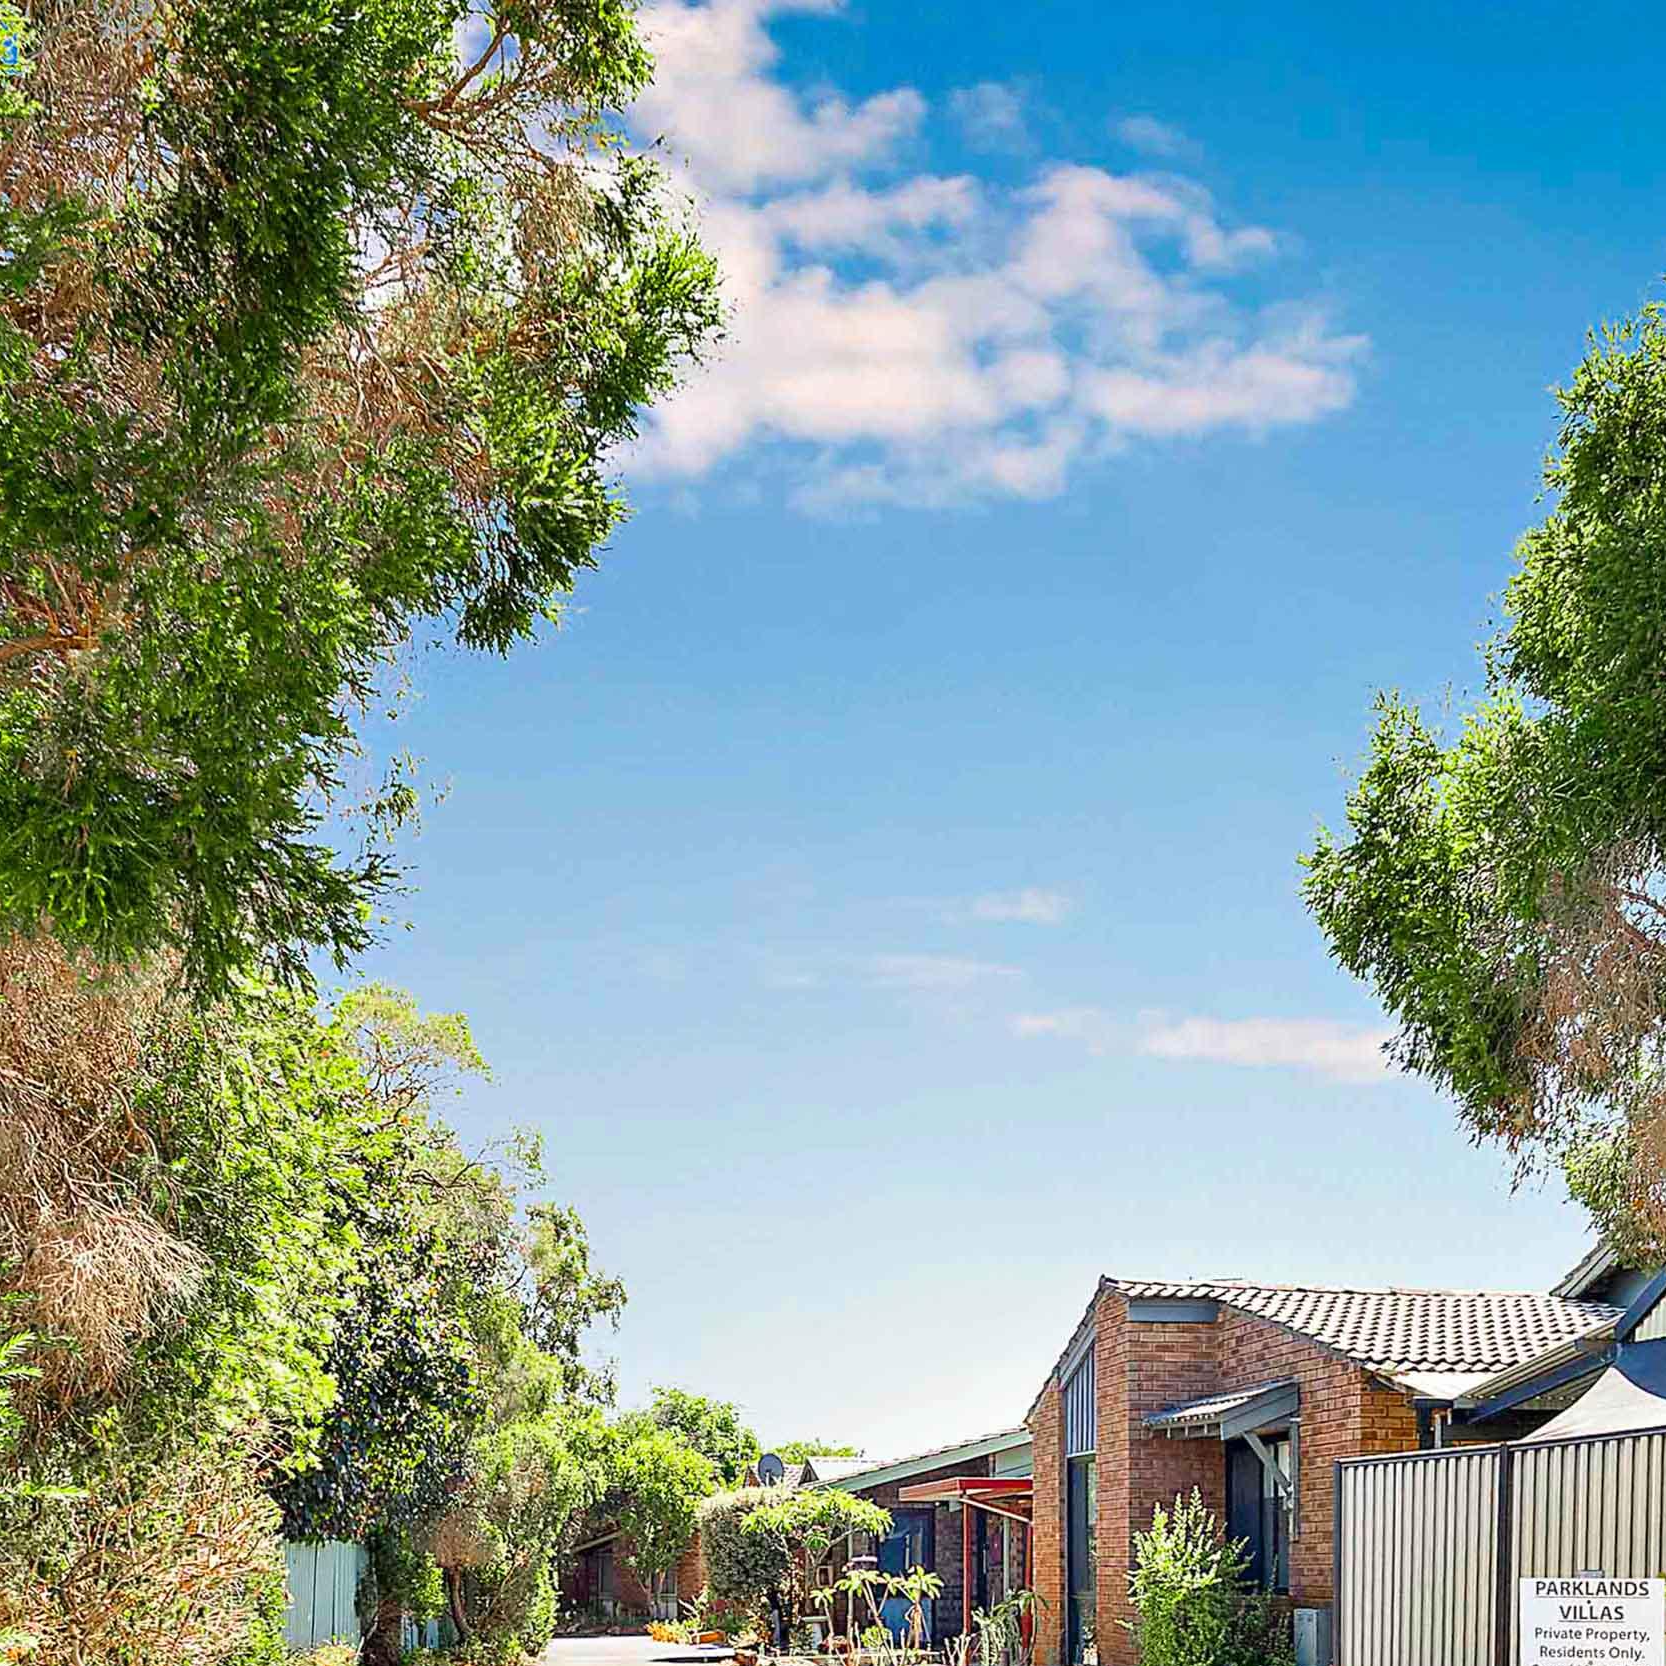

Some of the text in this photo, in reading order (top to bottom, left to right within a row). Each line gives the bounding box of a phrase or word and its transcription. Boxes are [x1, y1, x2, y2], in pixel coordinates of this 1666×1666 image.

[1536, 1581, 1649, 1596] PARKLANDS
[1559, 1605, 1624, 1620] VILLAS
[1535, 1627, 1650, 1642] Private Property,
[1540, 1646, 1645, 1661] Residents Only.
